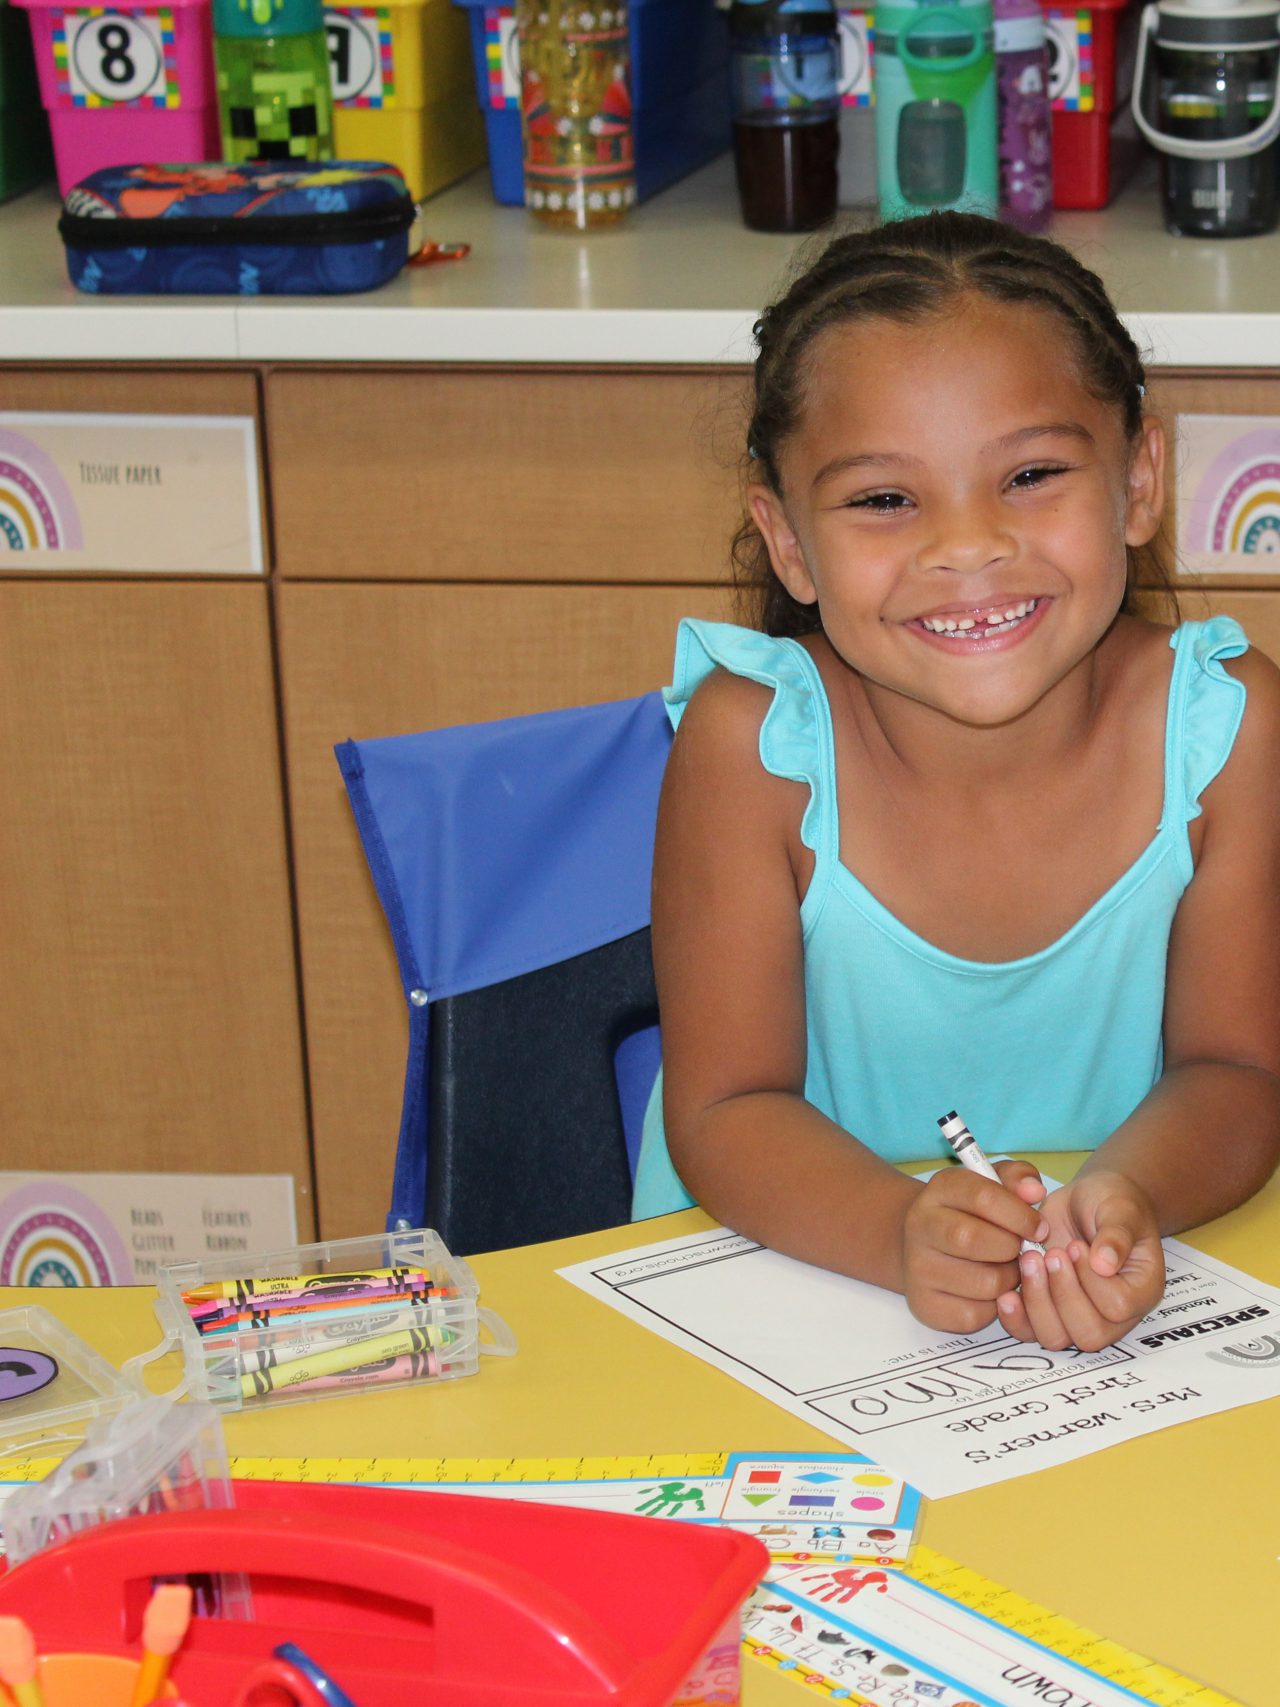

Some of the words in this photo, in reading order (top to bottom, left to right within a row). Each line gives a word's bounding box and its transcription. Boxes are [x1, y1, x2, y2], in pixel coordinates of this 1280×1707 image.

[98, 23, 134, 83] 8
[1157, 1297, 1218, 1319] Monday:
[1140, 1306, 1270, 1348] SPECIALS
[918, 1347, 937, 1357] is
[939, 1337, 979, 1351] This
[882, 1352, 915, 1365] me:
[1040, 1361, 1085, 1382] folder
[1053, 1372, 1145, 1405] First
[1123, 1387, 1201, 1413] Mrs.
[944, 1400, 1048, 1433] Grade
[777, 1507, 844, 1521] shapes
[807, 1539, 842, 1552] Bb
[857, 1541, 897, 1555] Aa
